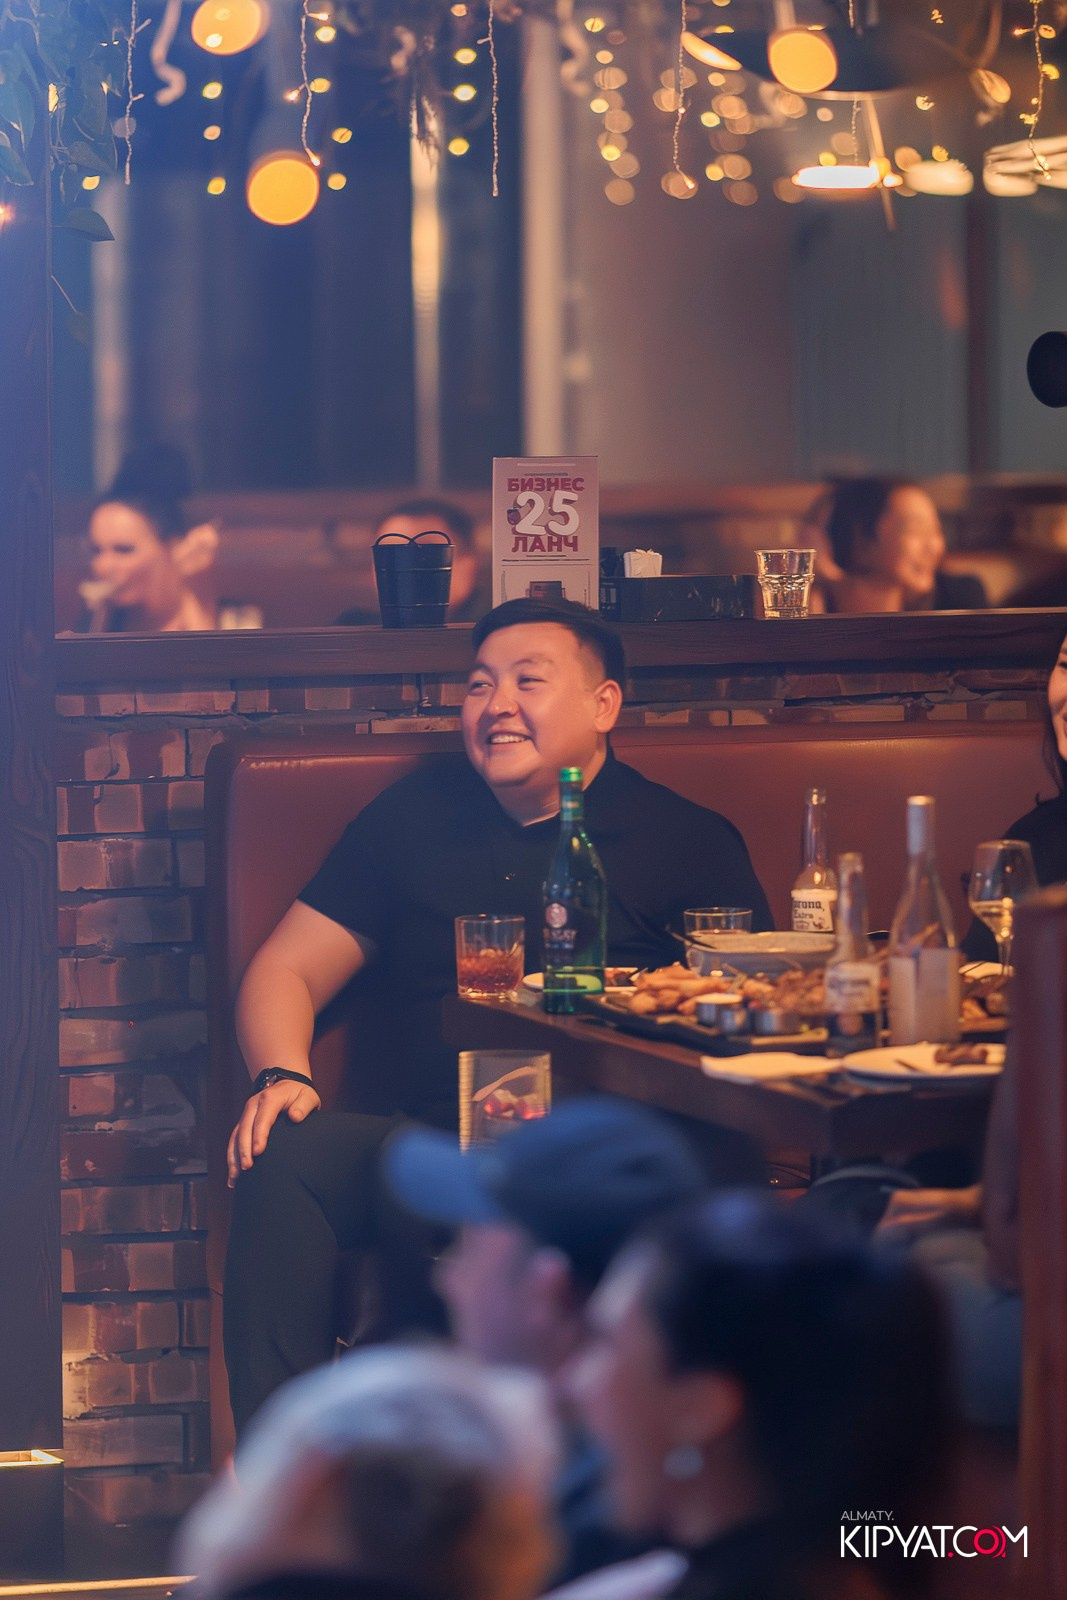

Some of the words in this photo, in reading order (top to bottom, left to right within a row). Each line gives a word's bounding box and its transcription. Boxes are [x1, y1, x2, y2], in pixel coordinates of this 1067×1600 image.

[507, 477, 585, 492] БИЗНЕС
[514, 490, 580, 536] 25
[512, 536, 578, 553] ЛАНЧ
